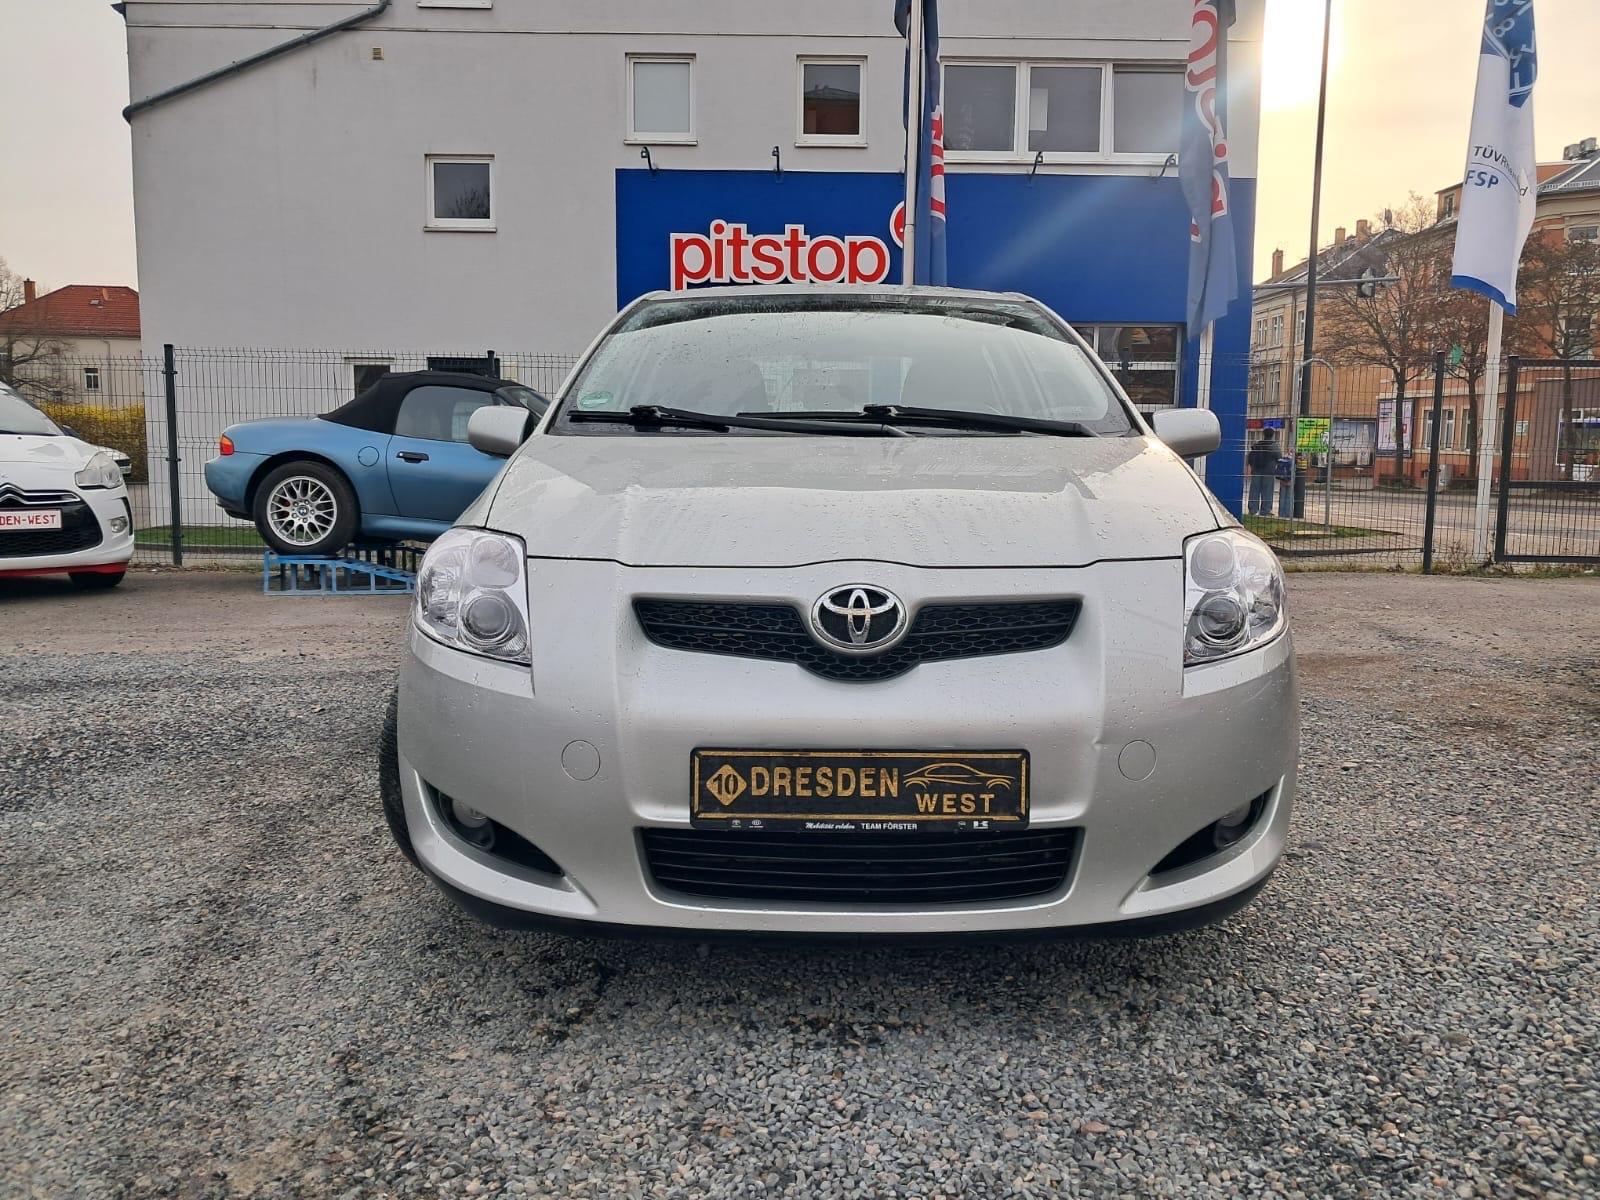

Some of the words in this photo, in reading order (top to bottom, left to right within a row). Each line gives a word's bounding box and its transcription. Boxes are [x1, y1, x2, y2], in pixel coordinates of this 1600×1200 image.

[1464, 169, 1499, 189] FSP
[672, 219, 889, 291] pitstop
[711, 772, 740, 796] 10
[751, 766, 899, 797] DRESDEN
[915, 793, 995, 813] WEST
[861, 822, 882, 830] TEAM
[883, 821, 917, 830] FÖRSTER
